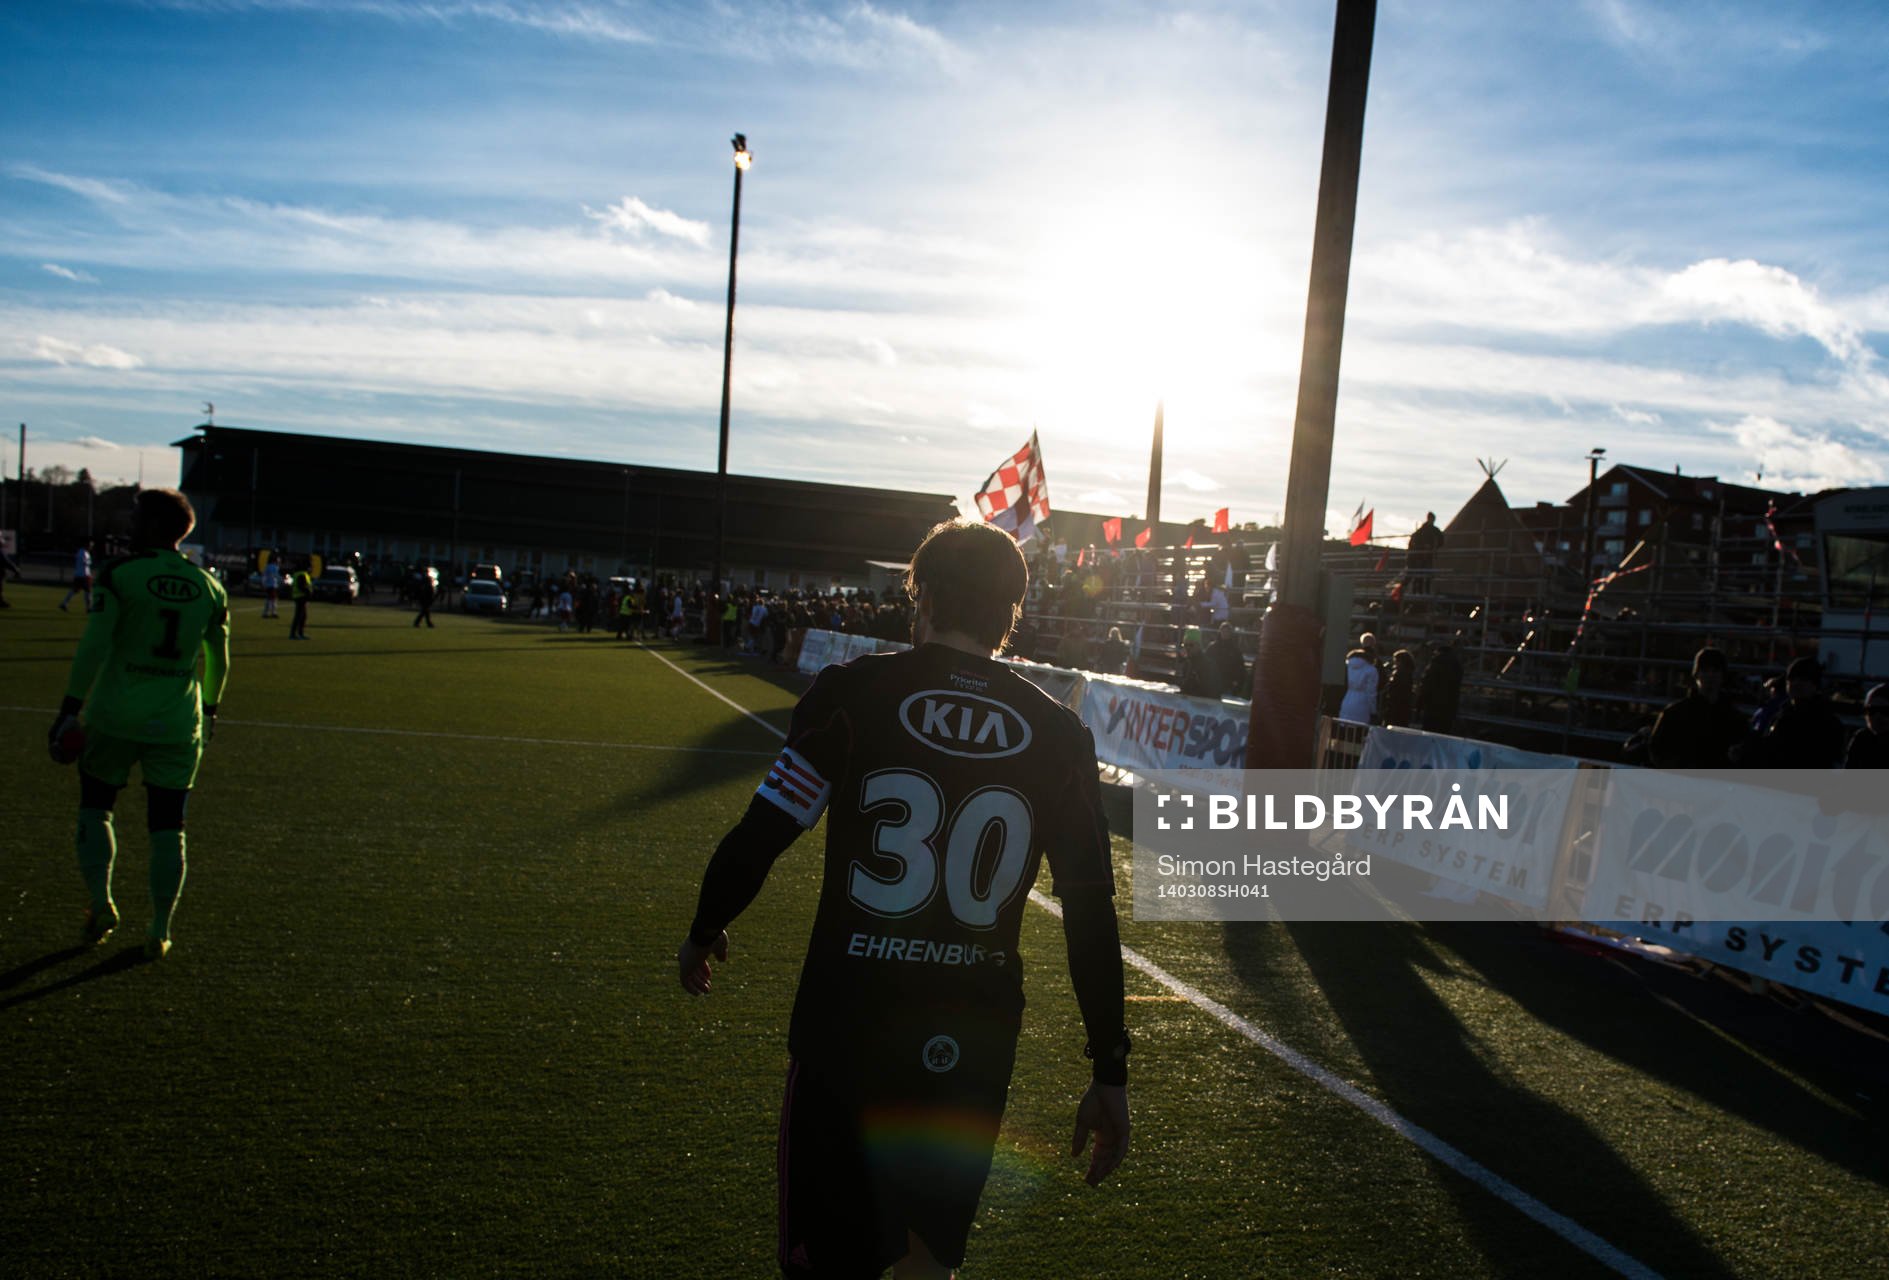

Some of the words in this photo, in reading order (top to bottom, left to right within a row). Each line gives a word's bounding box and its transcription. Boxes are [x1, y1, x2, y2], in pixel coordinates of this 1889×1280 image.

[156, 583, 193, 597] KIA
[153, 609, 181, 658] 1
[921, 698, 1009, 749] KIA
[1123, 699, 1248, 768] INTERSPOR
[847, 767, 1034, 931] 30
[1417, 839, 1529, 890] SYSTEM
[1614, 894, 1694, 933] ERP
